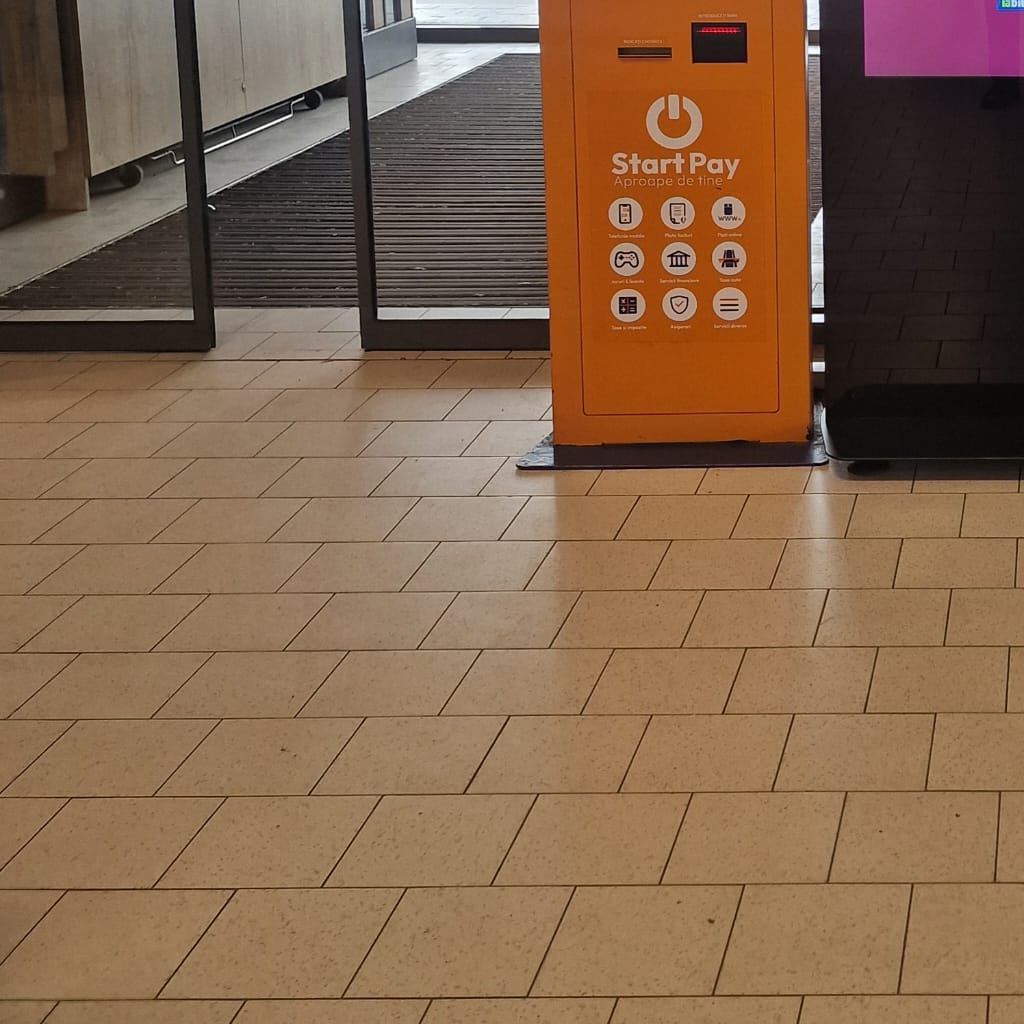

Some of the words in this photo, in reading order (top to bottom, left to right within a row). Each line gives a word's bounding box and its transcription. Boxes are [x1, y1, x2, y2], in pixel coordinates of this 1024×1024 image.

[614, 176, 673, 188] Aproape
[677, 175, 694, 186] de
[699, 175, 723, 186] tine
